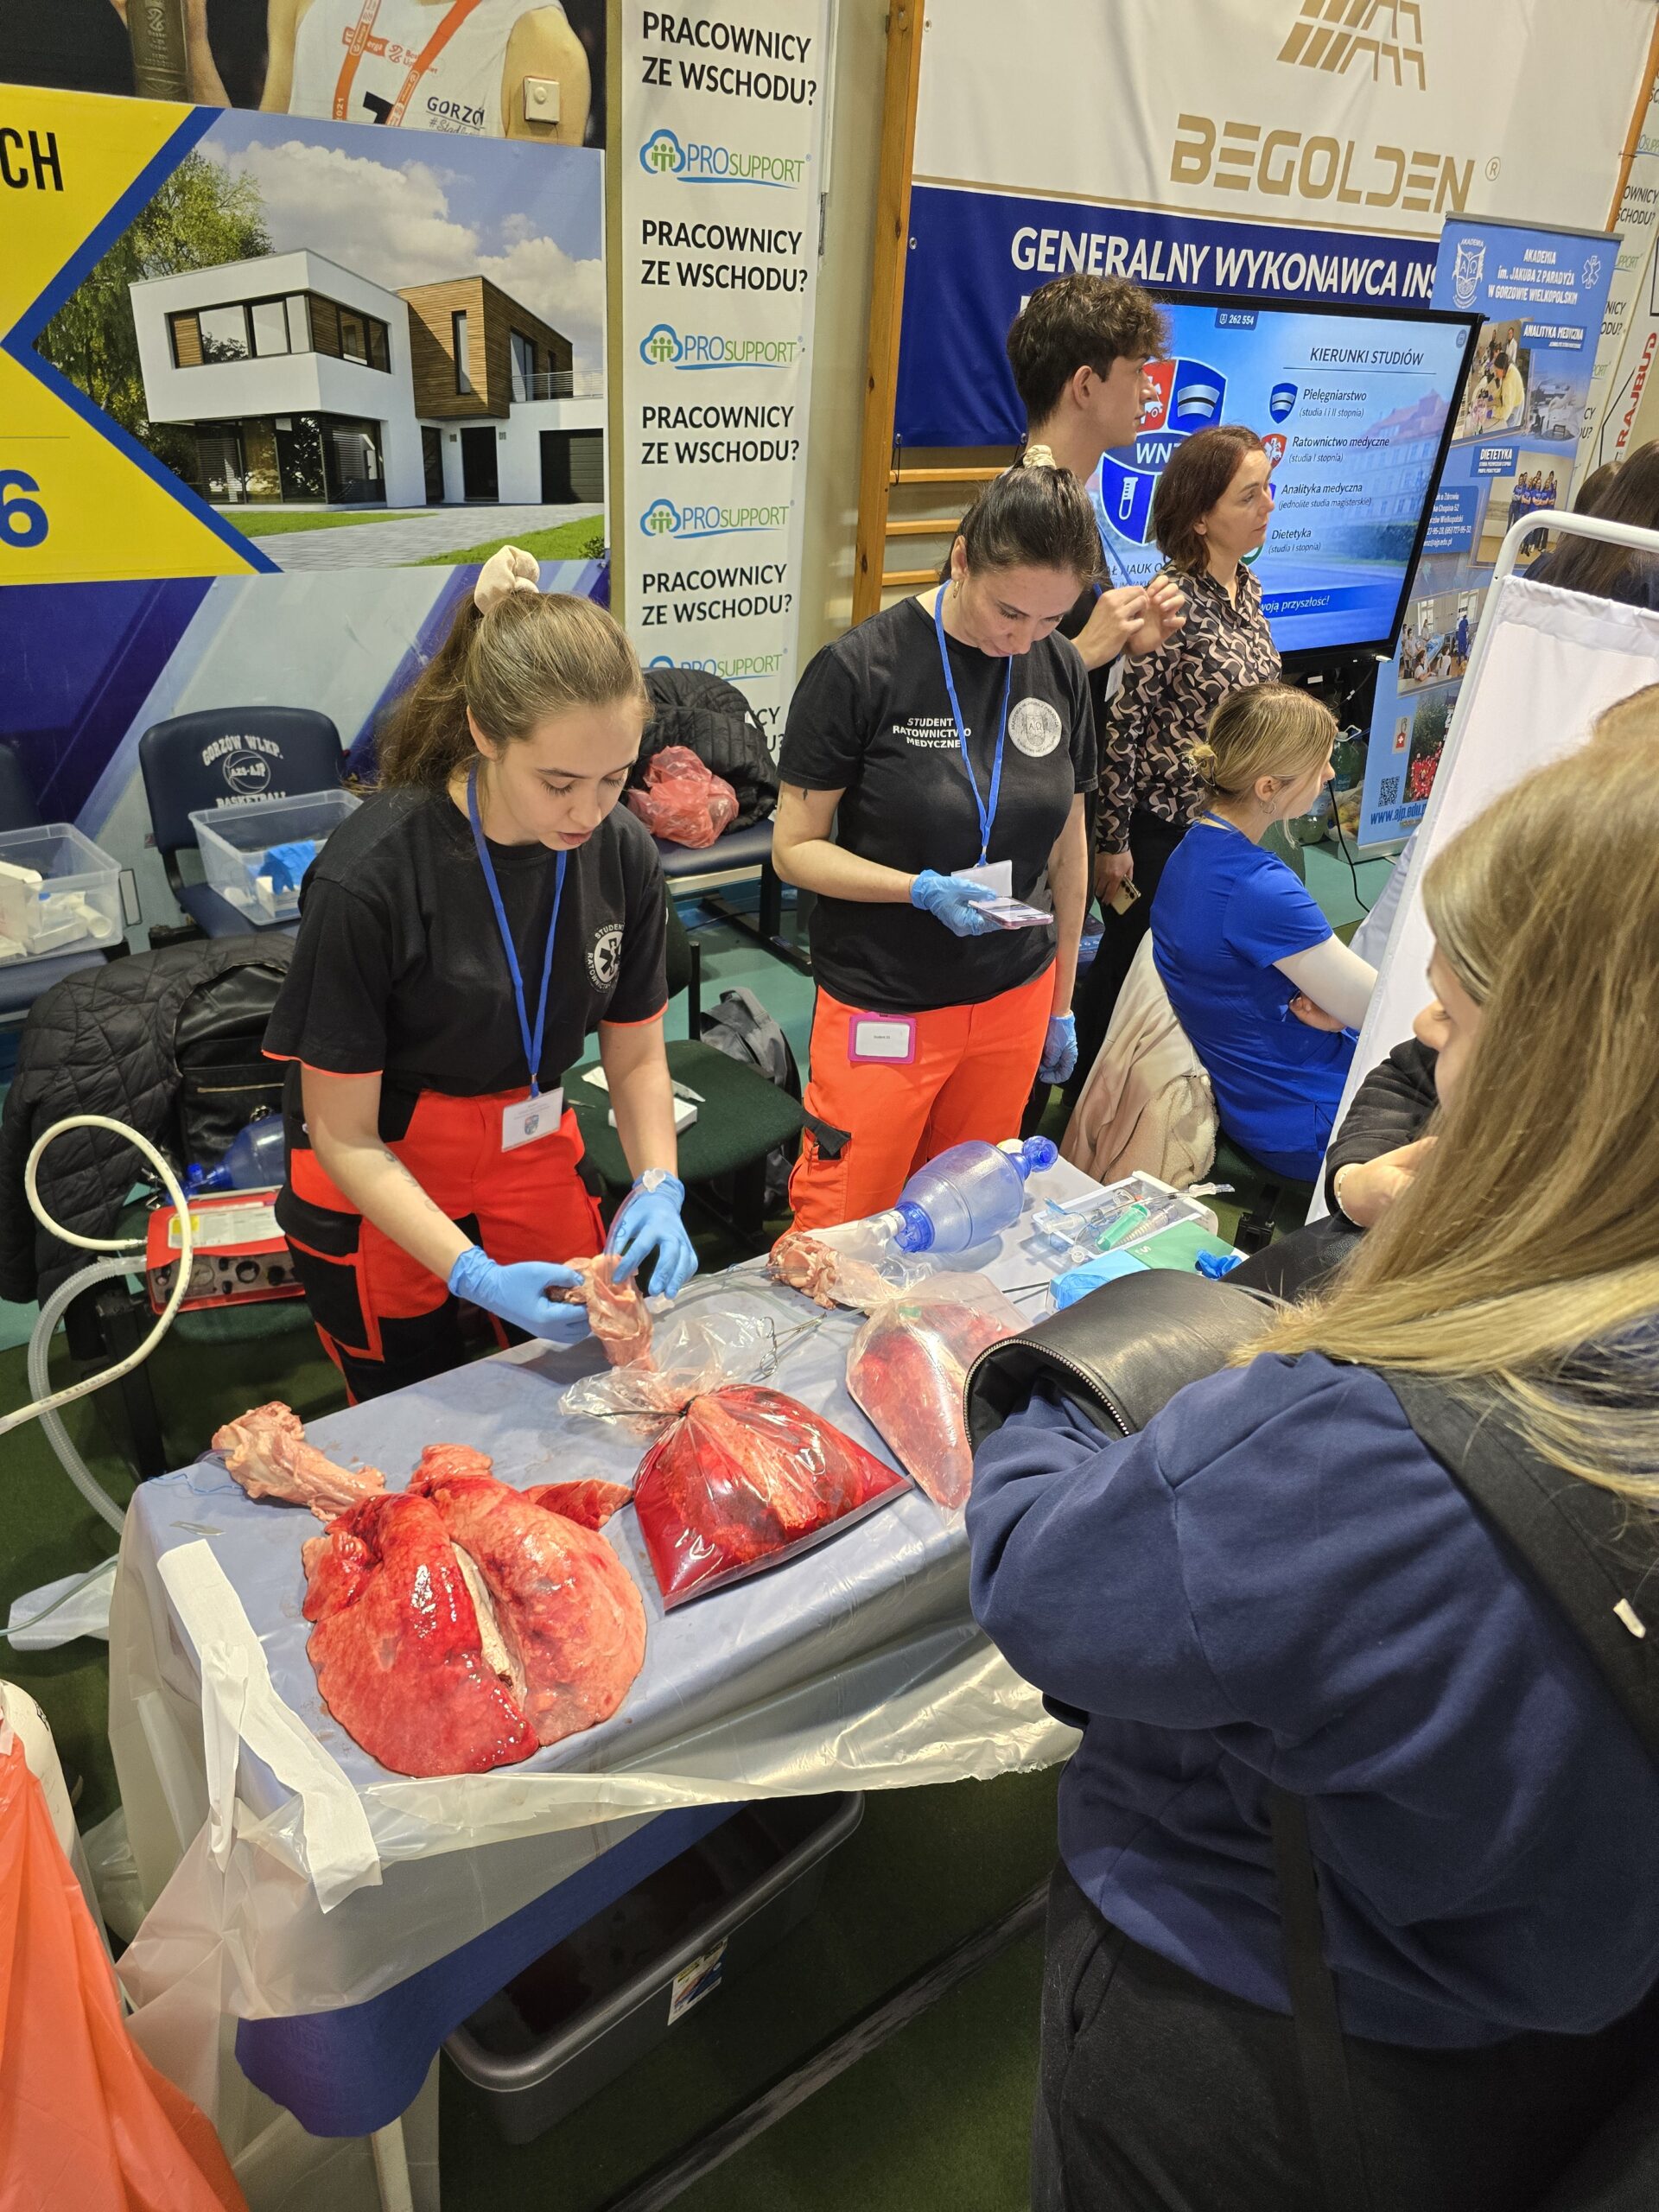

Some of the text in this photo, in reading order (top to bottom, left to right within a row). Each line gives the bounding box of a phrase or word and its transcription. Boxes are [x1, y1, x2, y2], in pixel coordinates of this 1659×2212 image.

[643, 10, 811, 64] PRACOWNICY
[642, 56, 817, 105] ZE WSCHODU?
[336, 98, 345, 120] 021
[427, 96, 486, 126] GORZÓ
[687, 143, 805, 183] PROSUPPORT
[1170, 113, 1476, 214] BEGOLDEN
[1624, 186, 1659, 205] OWNICY
[1616, 207, 1656, 226] SCHODU?
[642, 219, 803, 256] PRACOWNICY
[1011, 226, 1211, 286] GENERALNY
[1216, 247, 1398, 296] WYKONAWCA
[1523, 248, 1556, 265] AKADEMIA
[641, 260, 808, 293] ZE WSCHODU?
[1497, 265, 1509, 279] im.
[1510, 267, 1535, 283] JAKUBA
[1536, 270, 1541, 283] Z
[1488, 285, 1579, 305] W GORZOWIE WIELKOPOLSKIM
[1229, 314, 1254, 326] 262 554
[1523, 324, 1584, 341] ANALITYKA MEDYCZNA
[684, 335, 797, 363] PROSUPPORT
[1310, 347, 1424, 366] KIERUNKI STUDIÓW
[1302, 388, 1367, 404] Pielęgniarstwo
[642, 405, 794, 429] PRACOWNICY
[1299, 407, 1322, 417] (studia
[1338, 408, 1364, 418] stopnia)
[641, 439, 800, 465] ZE WSCHODU?
[1292, 436, 1389, 449] Ratownictwo medyczne
[1288, 454, 1312, 463] (studia
[1317, 454, 1344, 463] stopnia)
[1479, 448, 1512, 461] DIETETYKA
[1281, 482, 1363, 495] Analityka medyczna
[1279, 498, 1372, 511] (jednolite studia magisterskie)
[683, 505, 790, 531] PROSUPPORT
[1271, 528, 1312, 541] Dietetyka
[1268, 543, 1290, 554] (studia
[1295, 543, 1321, 553] stopnia)
[642, 563, 787, 594] PRACOWNICY
[641, 594, 792, 626] ZE WSCHODU?
[1261, 595, 1330, 613] woją przyszłość!
[907, 717, 954, 728] STUDENT
[202, 734, 284, 766] GORZÓW WLKP.
[906, 737, 961, 748] MEDYCZNE
[1370, 802, 1427, 825] www.ajp.edu.p
[594, 923, 625, 939] STUDEN
